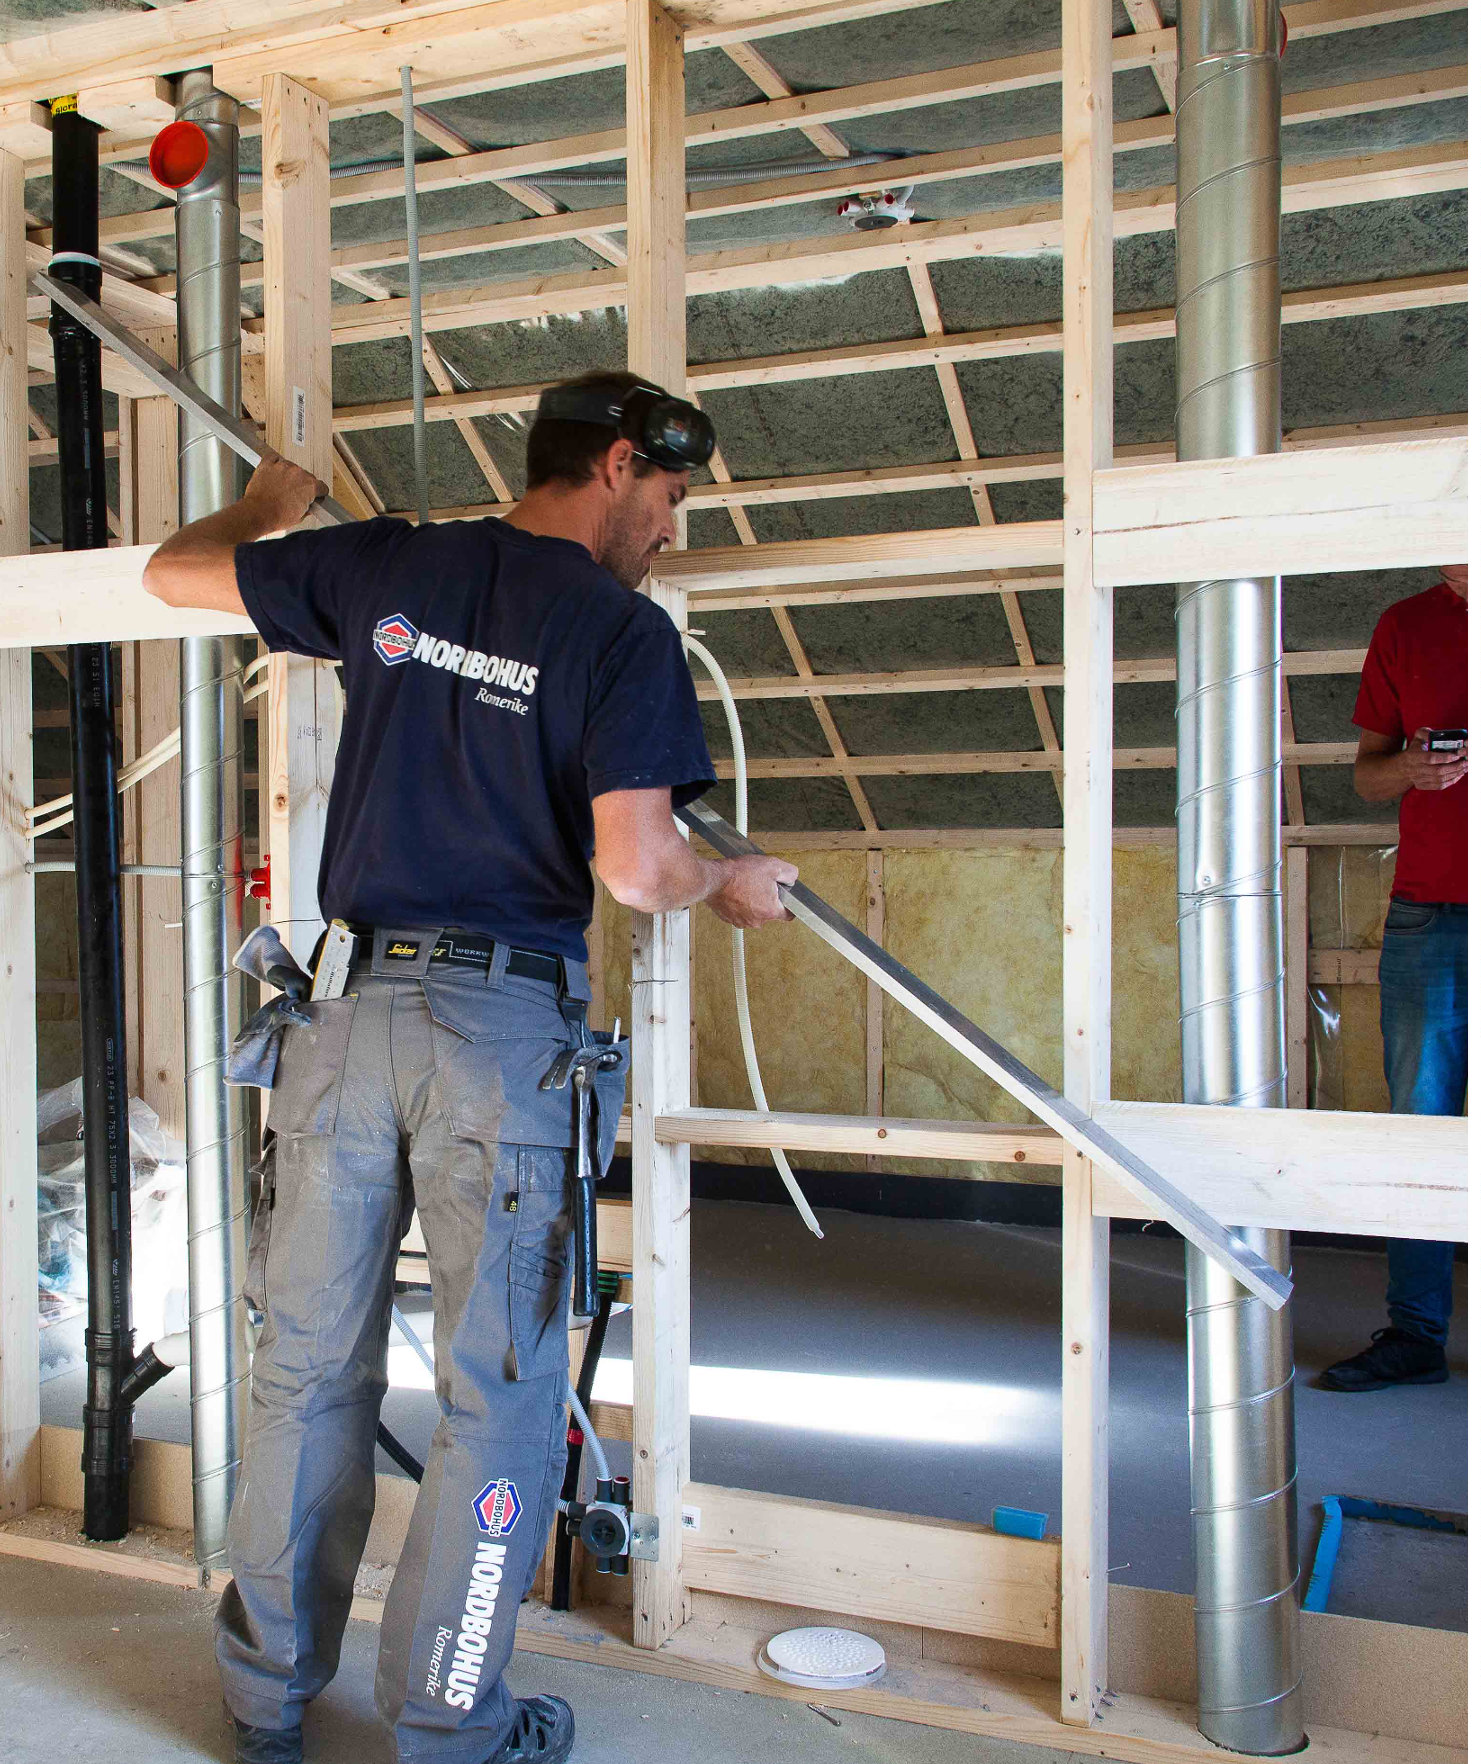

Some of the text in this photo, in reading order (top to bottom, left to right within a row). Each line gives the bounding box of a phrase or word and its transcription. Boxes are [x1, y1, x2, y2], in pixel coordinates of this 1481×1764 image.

[508, 1200, 516, 1211] 48
[490, 1480, 507, 1536] NORDBOHUS
[444, 1541, 507, 1712] NORDBOHUS
[426, 1625, 453, 1697] Romerike
